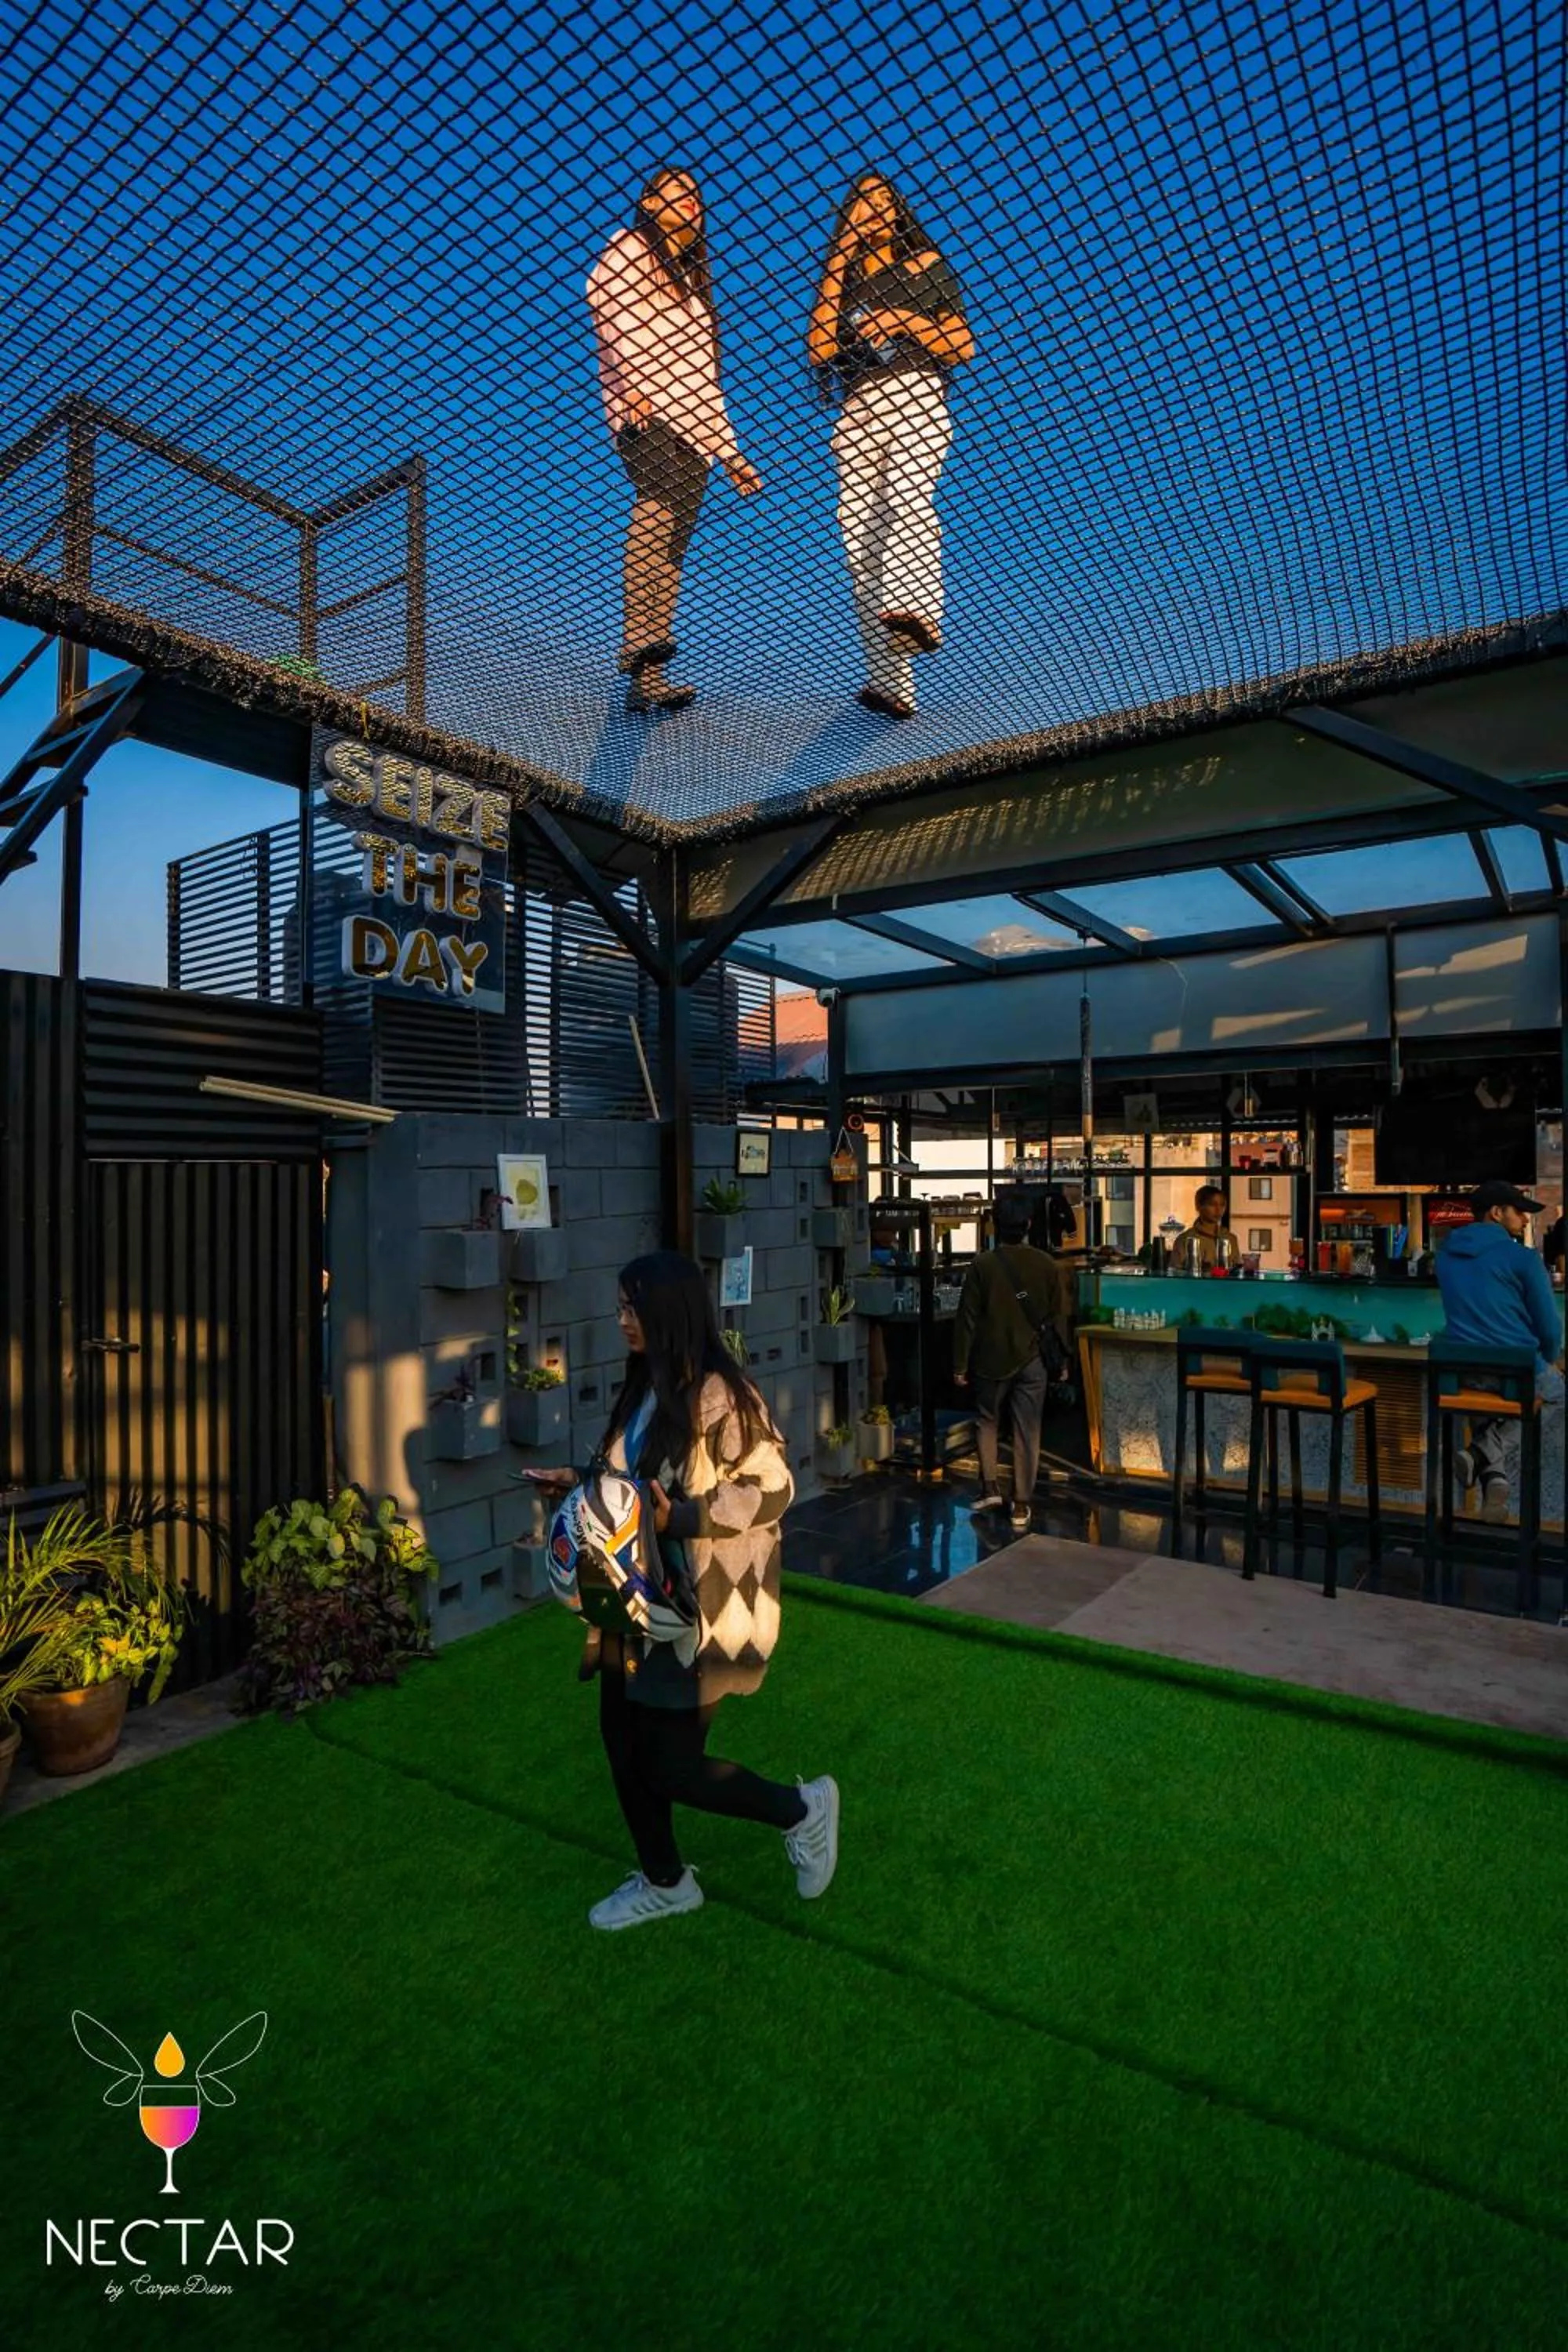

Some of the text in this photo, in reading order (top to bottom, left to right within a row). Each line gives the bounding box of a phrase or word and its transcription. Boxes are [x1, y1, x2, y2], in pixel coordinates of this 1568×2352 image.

[325, 740, 510, 851] SEIZE
[354, 831, 482, 920] THE
[342, 915, 488, 996] DAY
